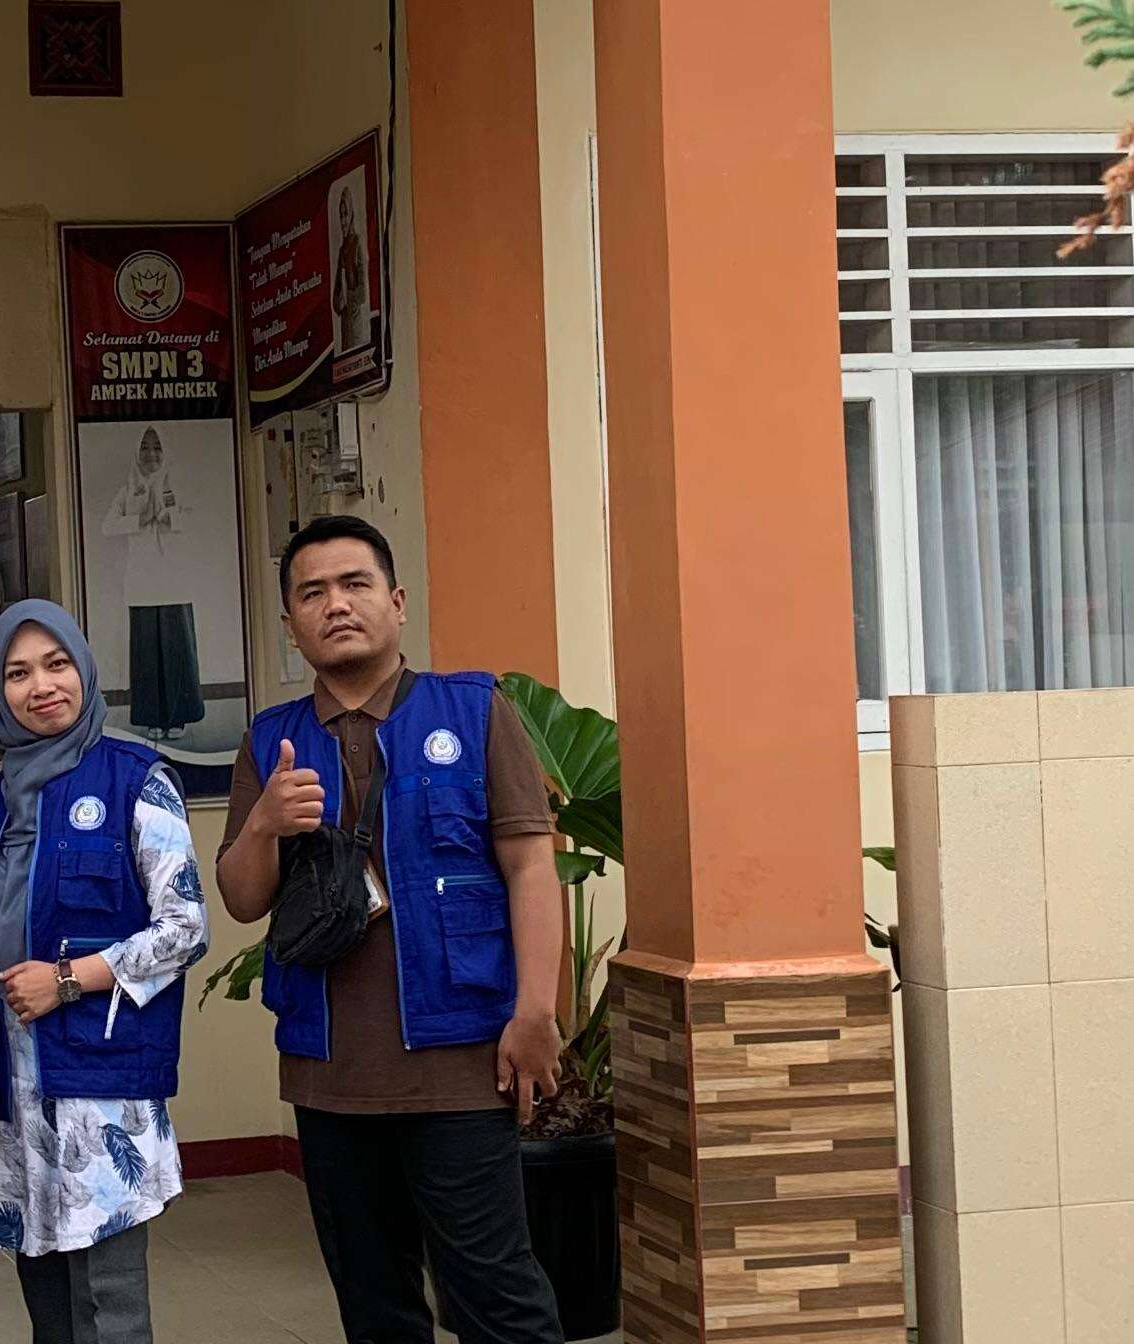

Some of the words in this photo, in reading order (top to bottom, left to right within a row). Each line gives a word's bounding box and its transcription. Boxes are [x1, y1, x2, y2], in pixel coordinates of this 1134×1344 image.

[83, 332, 143, 346] Selamat
[145, 330, 202, 346] Datang
[205, 330, 220, 342] di
[102, 351, 177, 379] SMPN
[186, 349, 203, 377] 3
[91, 384, 148, 400] AMPEK
[152, 381, 218, 398] ANGKEK
